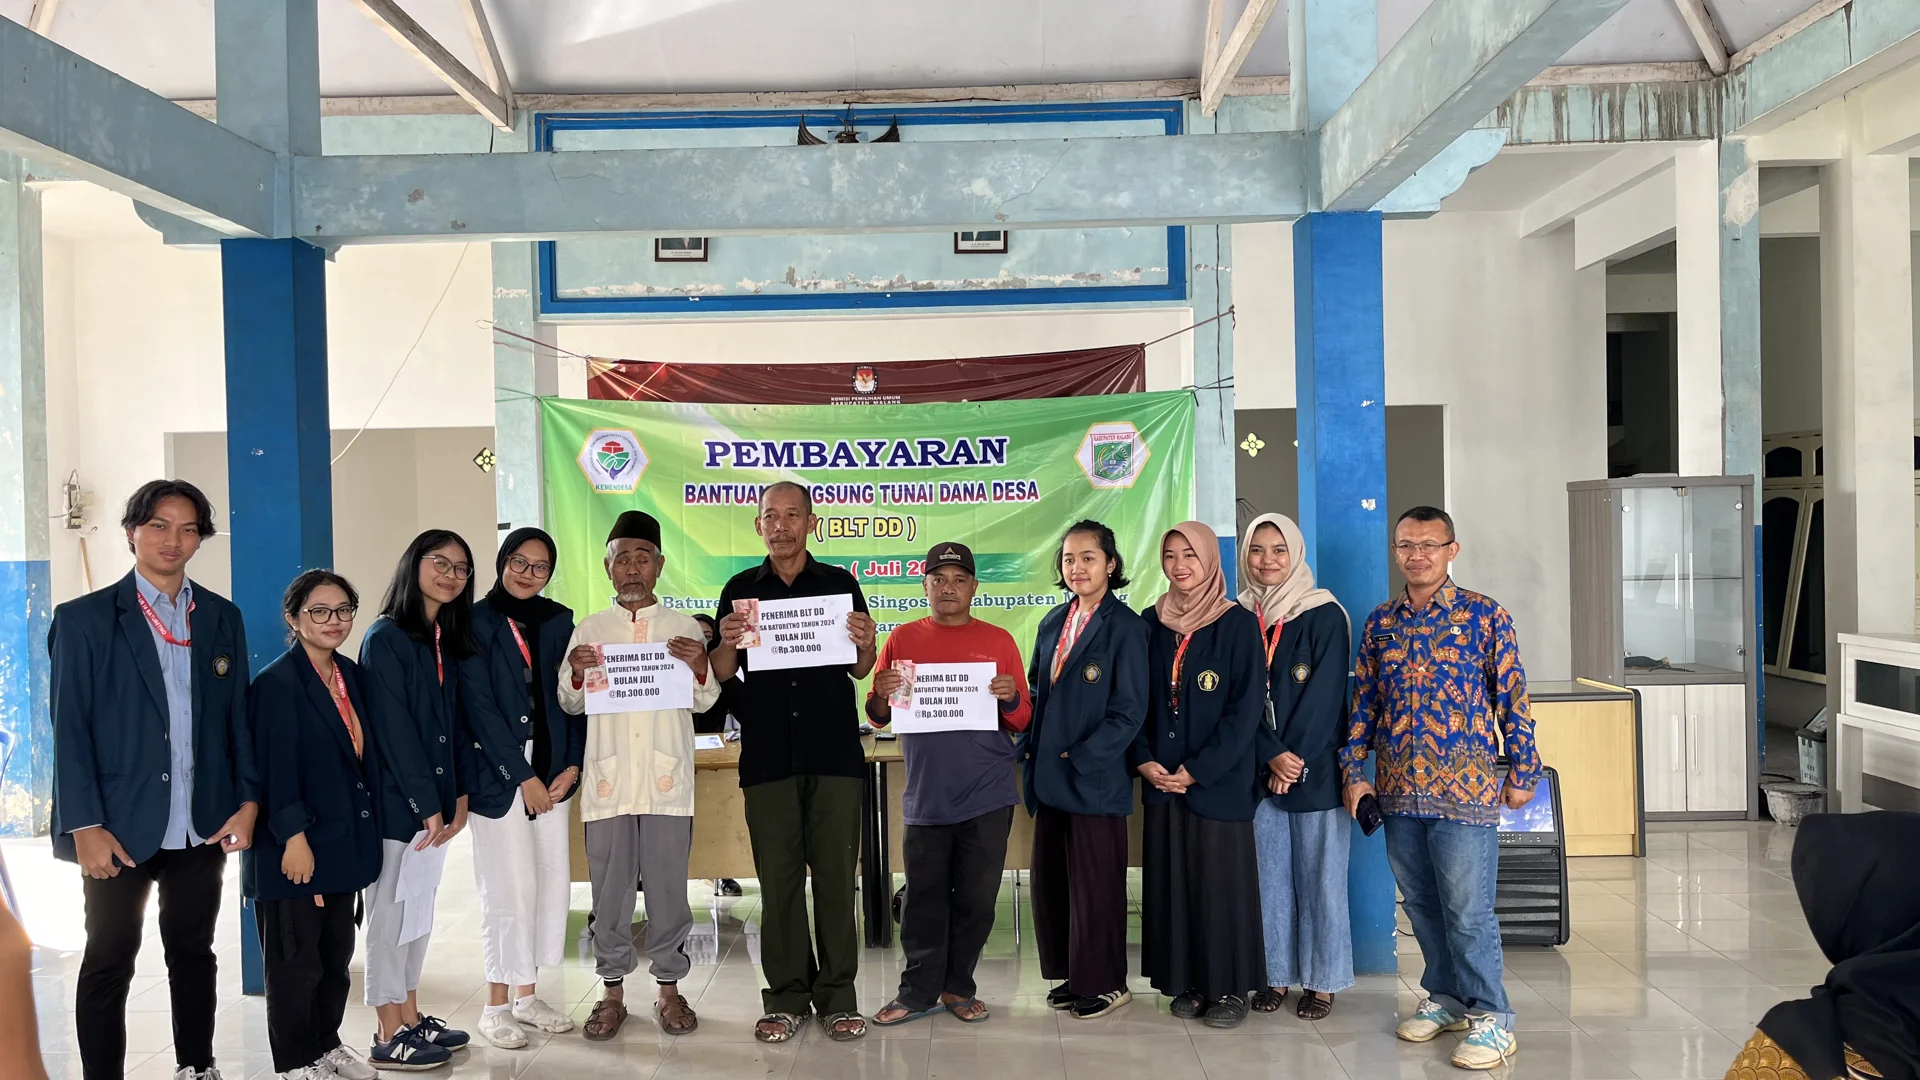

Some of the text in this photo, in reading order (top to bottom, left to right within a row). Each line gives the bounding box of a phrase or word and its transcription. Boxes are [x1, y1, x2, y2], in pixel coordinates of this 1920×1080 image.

[703, 437, 1008, 468] PEMBAYARAN
[879, 483, 934, 504] TUNAI
[939, 482, 988, 502] DANA
[992, 480, 1039, 501] DESA
[828, 517, 869, 537] BLT
[873, 516, 903, 537] DD
[864, 561, 901, 576] Juli
[661, 596, 720, 609] Bature
[868, 594, 931, 611] Singos
[761, 607, 825, 621] PENERIMA BLT DD
[145, 608, 167, 635] BATURETNO
[768, 622, 800, 631] BATURETNO
[801, 620, 819, 628] TAHUN
[820, 619, 835, 627] 2024
[774, 631, 815, 642] BULAN JULI
[771, 643, 822, 655] @Rp.300.000
[640, 652, 653, 660] BLT
[655, 652, 665, 660] DD
[608, 663, 675, 673] BATURETNO TAHUN 2024
[614, 675, 655, 685] BULAN JULI
[914, 674, 969, 683] NERIMA BLT DD
[609, 687, 660, 699] @Rp.300.000
[919, 696, 959, 705] BULAN JULI
[914, 709, 964, 719] @Rp.300.000
